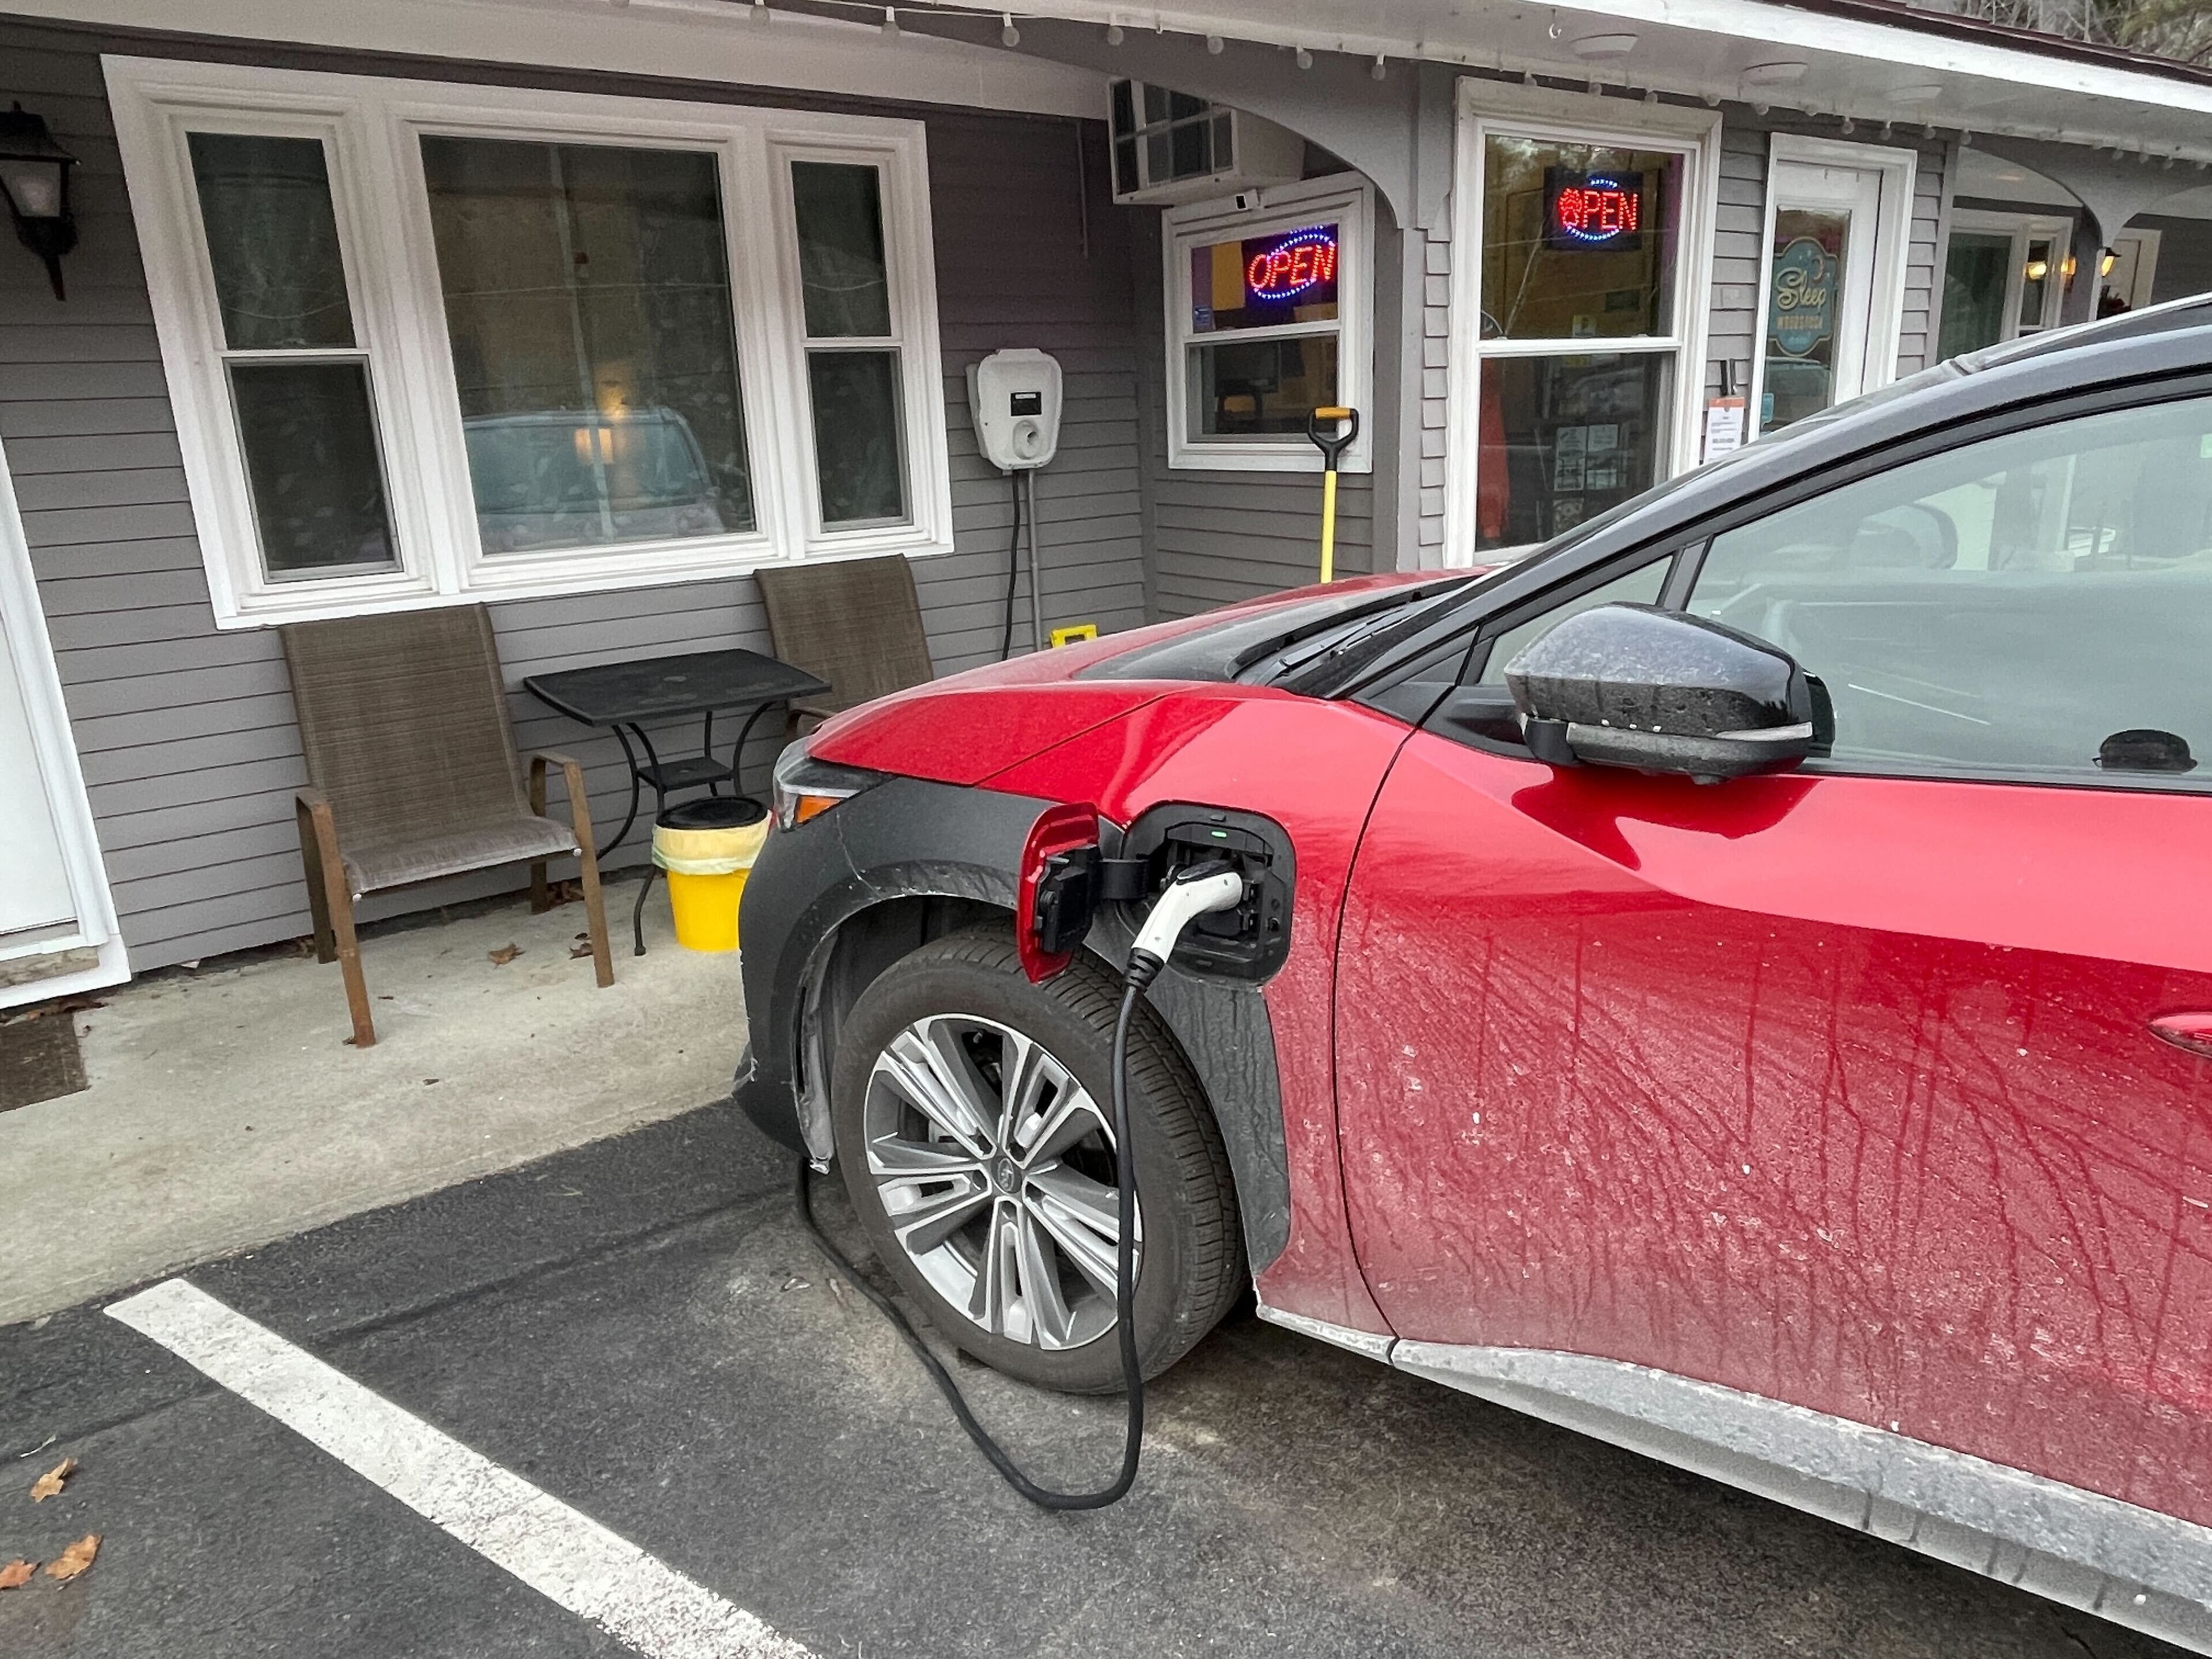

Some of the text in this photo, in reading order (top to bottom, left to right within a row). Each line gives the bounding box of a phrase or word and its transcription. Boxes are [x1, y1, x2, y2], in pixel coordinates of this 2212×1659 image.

[1559, 188, 1638, 230] OPEN
[1249, 244, 1335, 288] OPEN
[1776, 267, 1826, 314] Sleep
